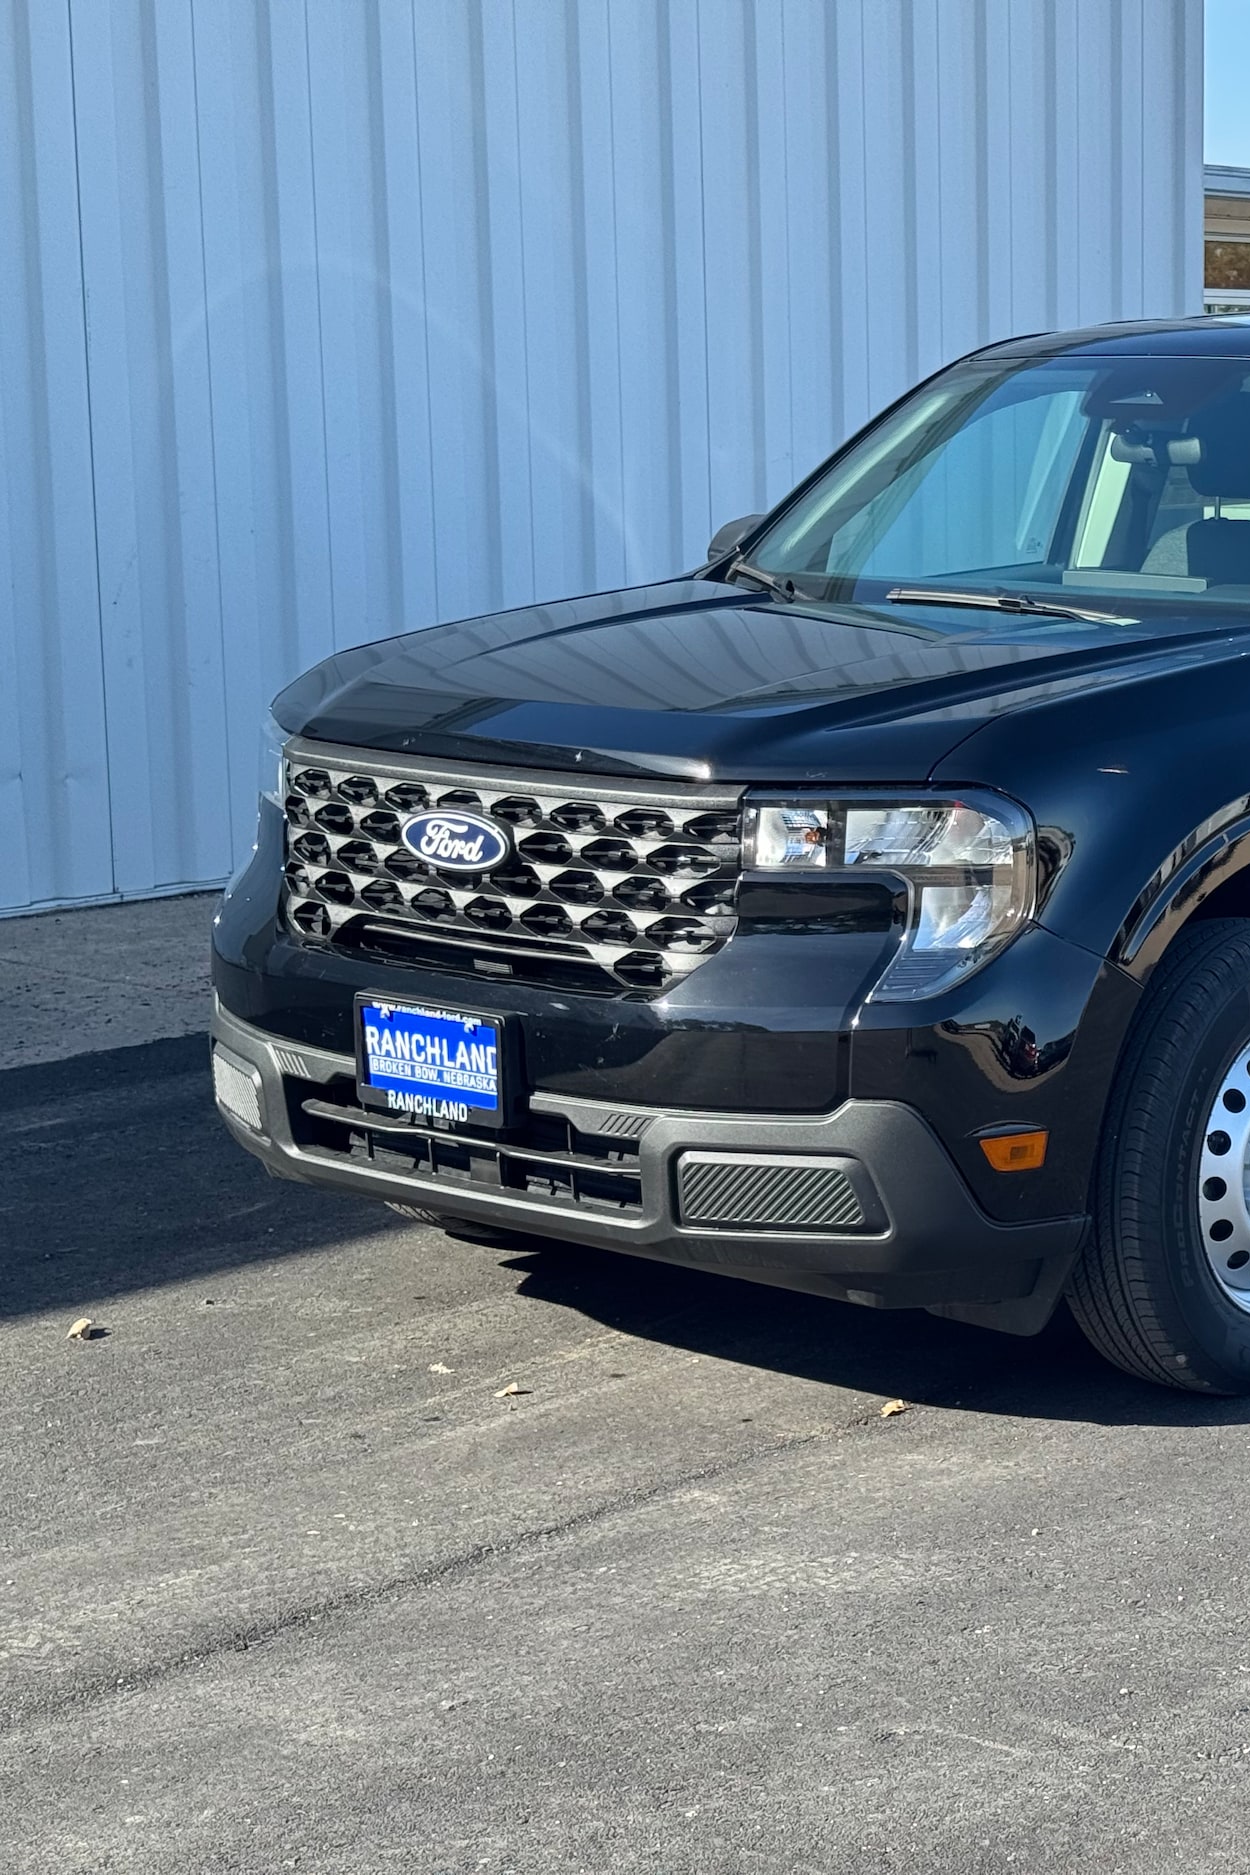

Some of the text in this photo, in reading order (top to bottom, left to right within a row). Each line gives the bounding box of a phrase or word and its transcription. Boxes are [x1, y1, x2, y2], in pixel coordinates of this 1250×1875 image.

[420, 819, 485, 862] Ford
[365, 1025, 497, 1075] RANCHLAND
[373, 1058, 411, 1077] BROKEN
[444, 1070, 497, 1091] NEBRASKA
[387, 1089, 468, 1123] RANCHLAND
